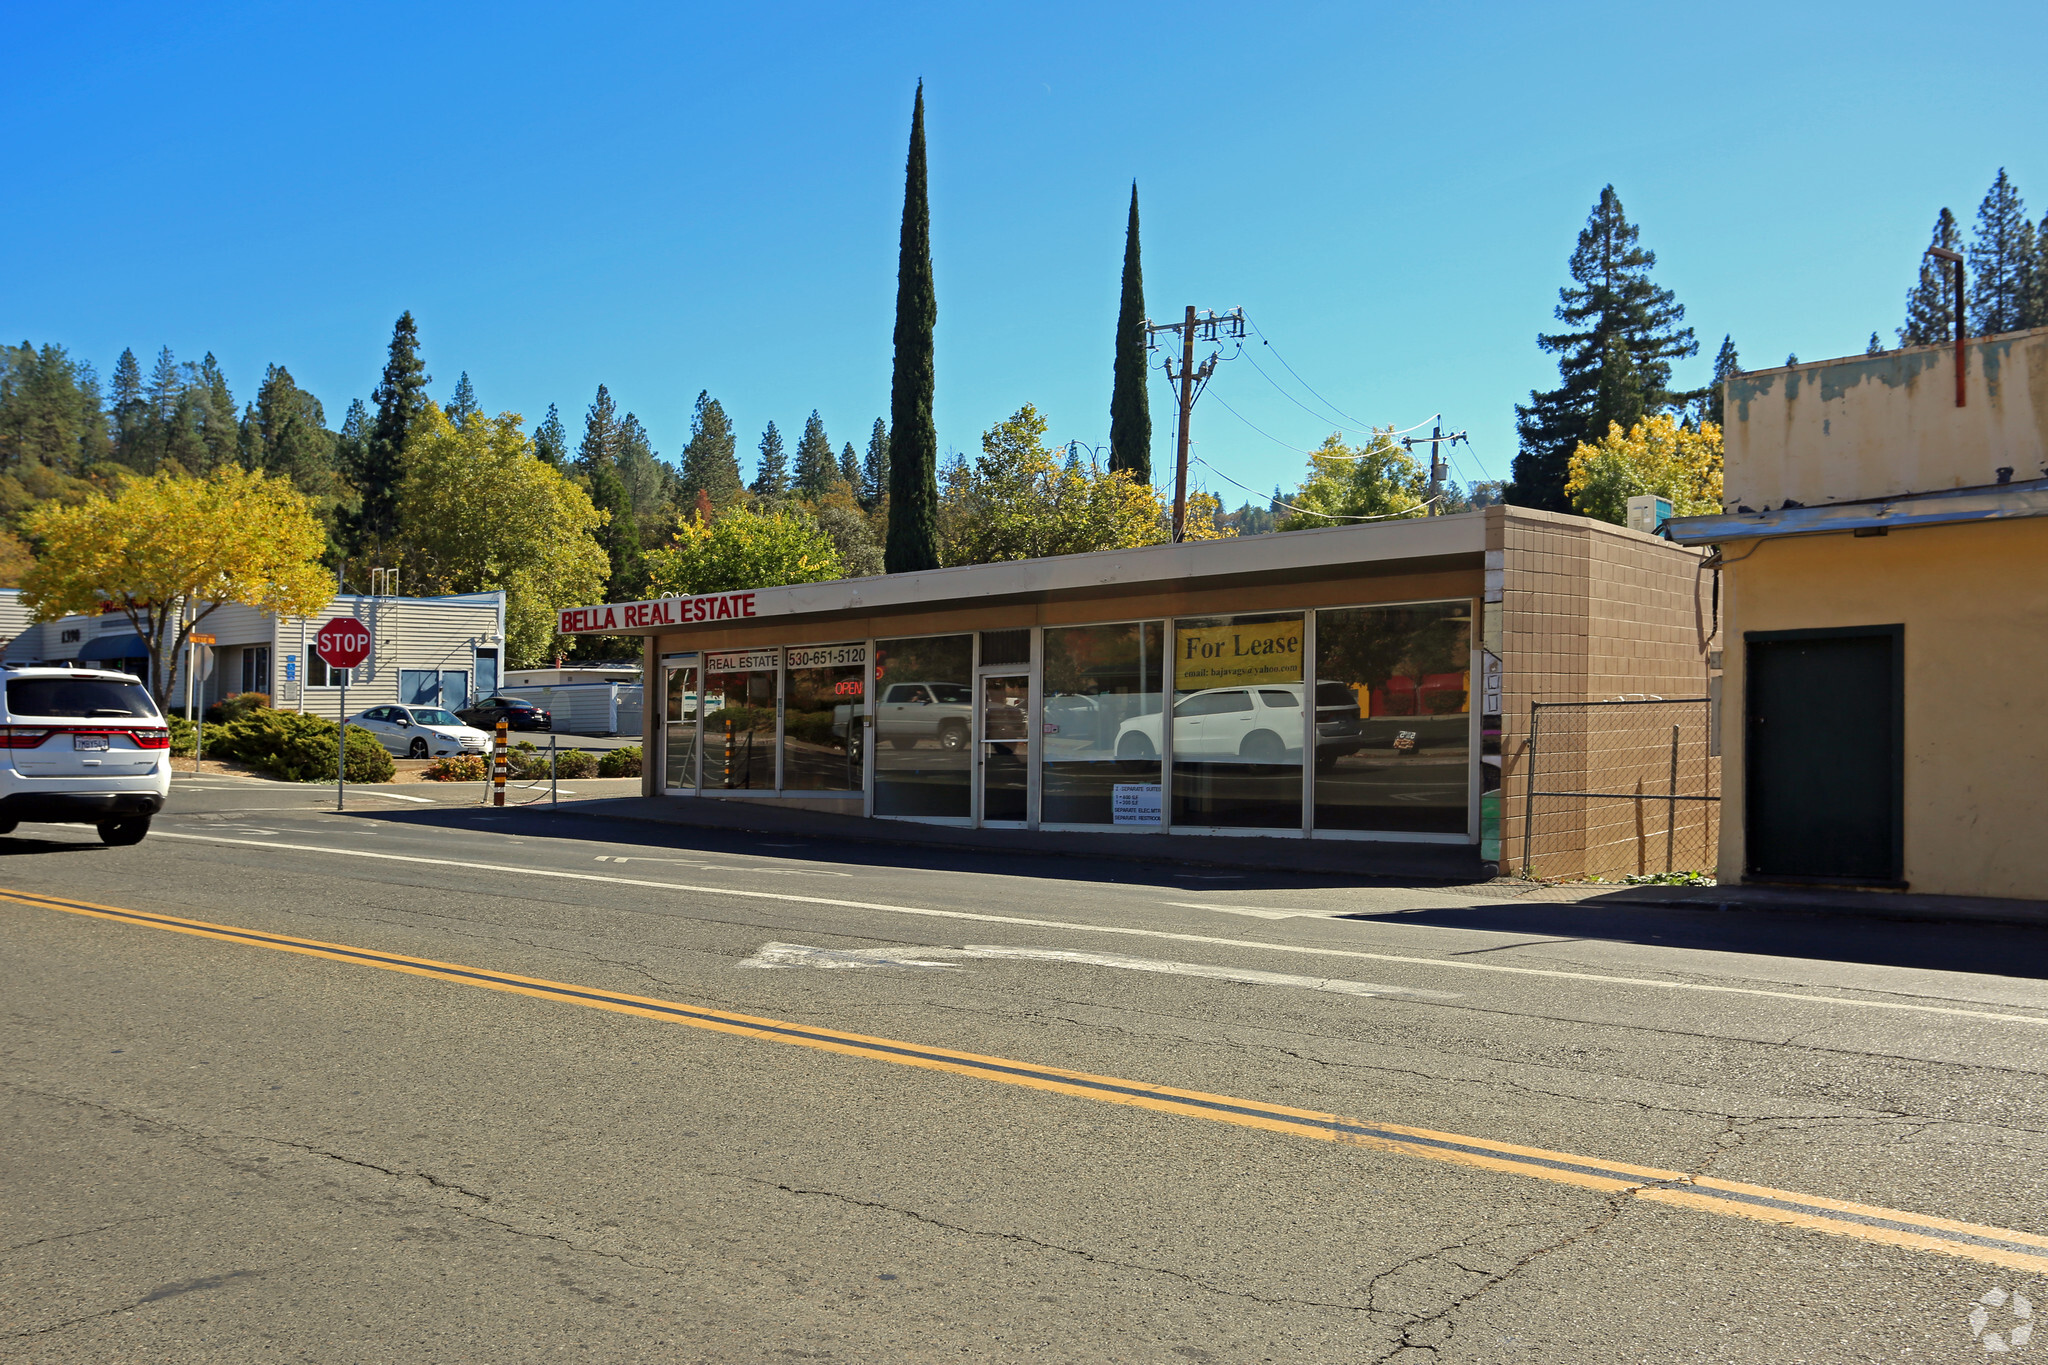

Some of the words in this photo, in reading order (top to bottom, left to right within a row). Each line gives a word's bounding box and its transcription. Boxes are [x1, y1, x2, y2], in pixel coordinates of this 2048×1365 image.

[561, 608, 617, 632] BELLA
[625, 603, 675, 627] REAL
[681, 593, 756, 622] ESTATE
[320, 633, 368, 652] STOP
[1185, 638, 1225, 659] For
[1232, 635, 1298, 656] Lease
[709, 657, 736, 670] REAL
[739, 655, 778, 668] ESTATE
[788, 648, 865, 667] 530-651-5120
[1184, 669, 1209, 677] email:
[835, 681, 862, 695] OPEN
